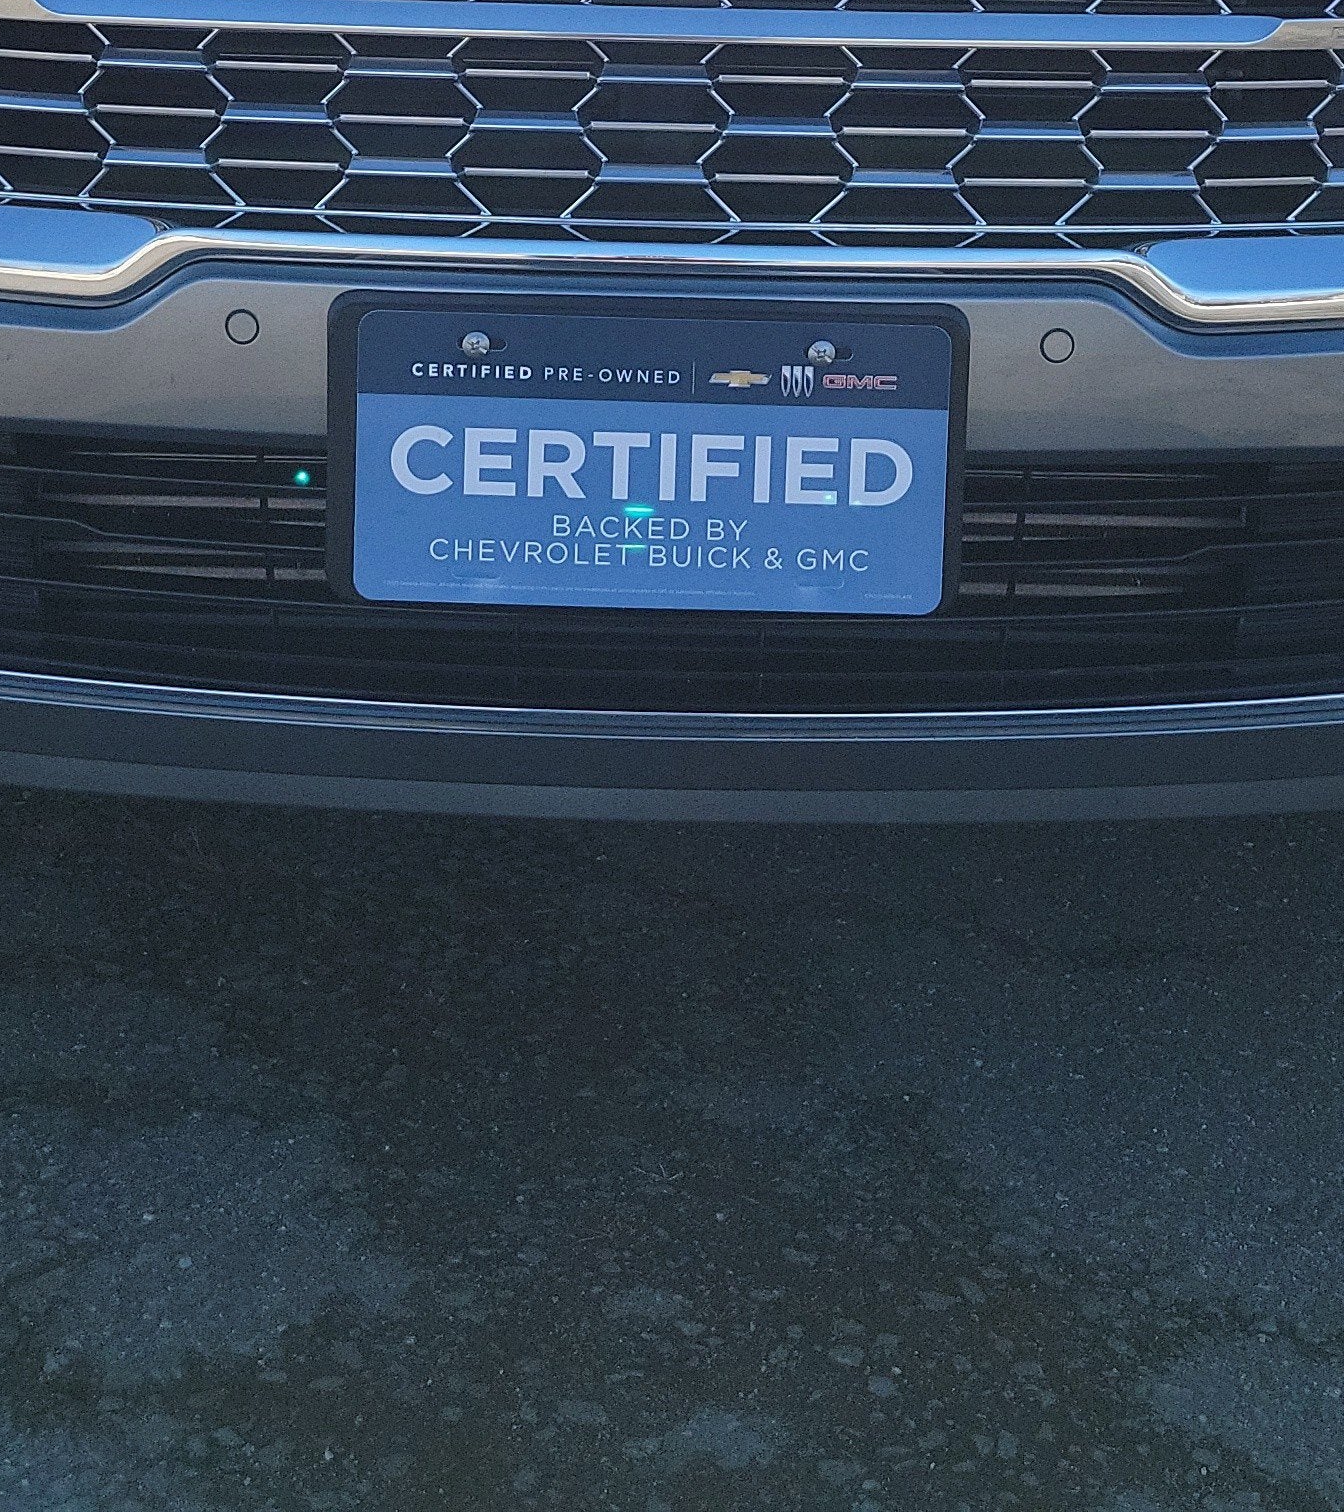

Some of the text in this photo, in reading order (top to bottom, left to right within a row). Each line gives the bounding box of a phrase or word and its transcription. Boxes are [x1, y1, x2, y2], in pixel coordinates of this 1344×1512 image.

[411, 362, 681, 385] CERTIFIED PRE-OWNED
[822, 374, 898, 390] GMC
[390, 424, 913, 507] CERTIFIED
[552, 514, 748, 541] BACKED BY
[429, 538, 870, 572] CHEVROLET BUICK & GMC
